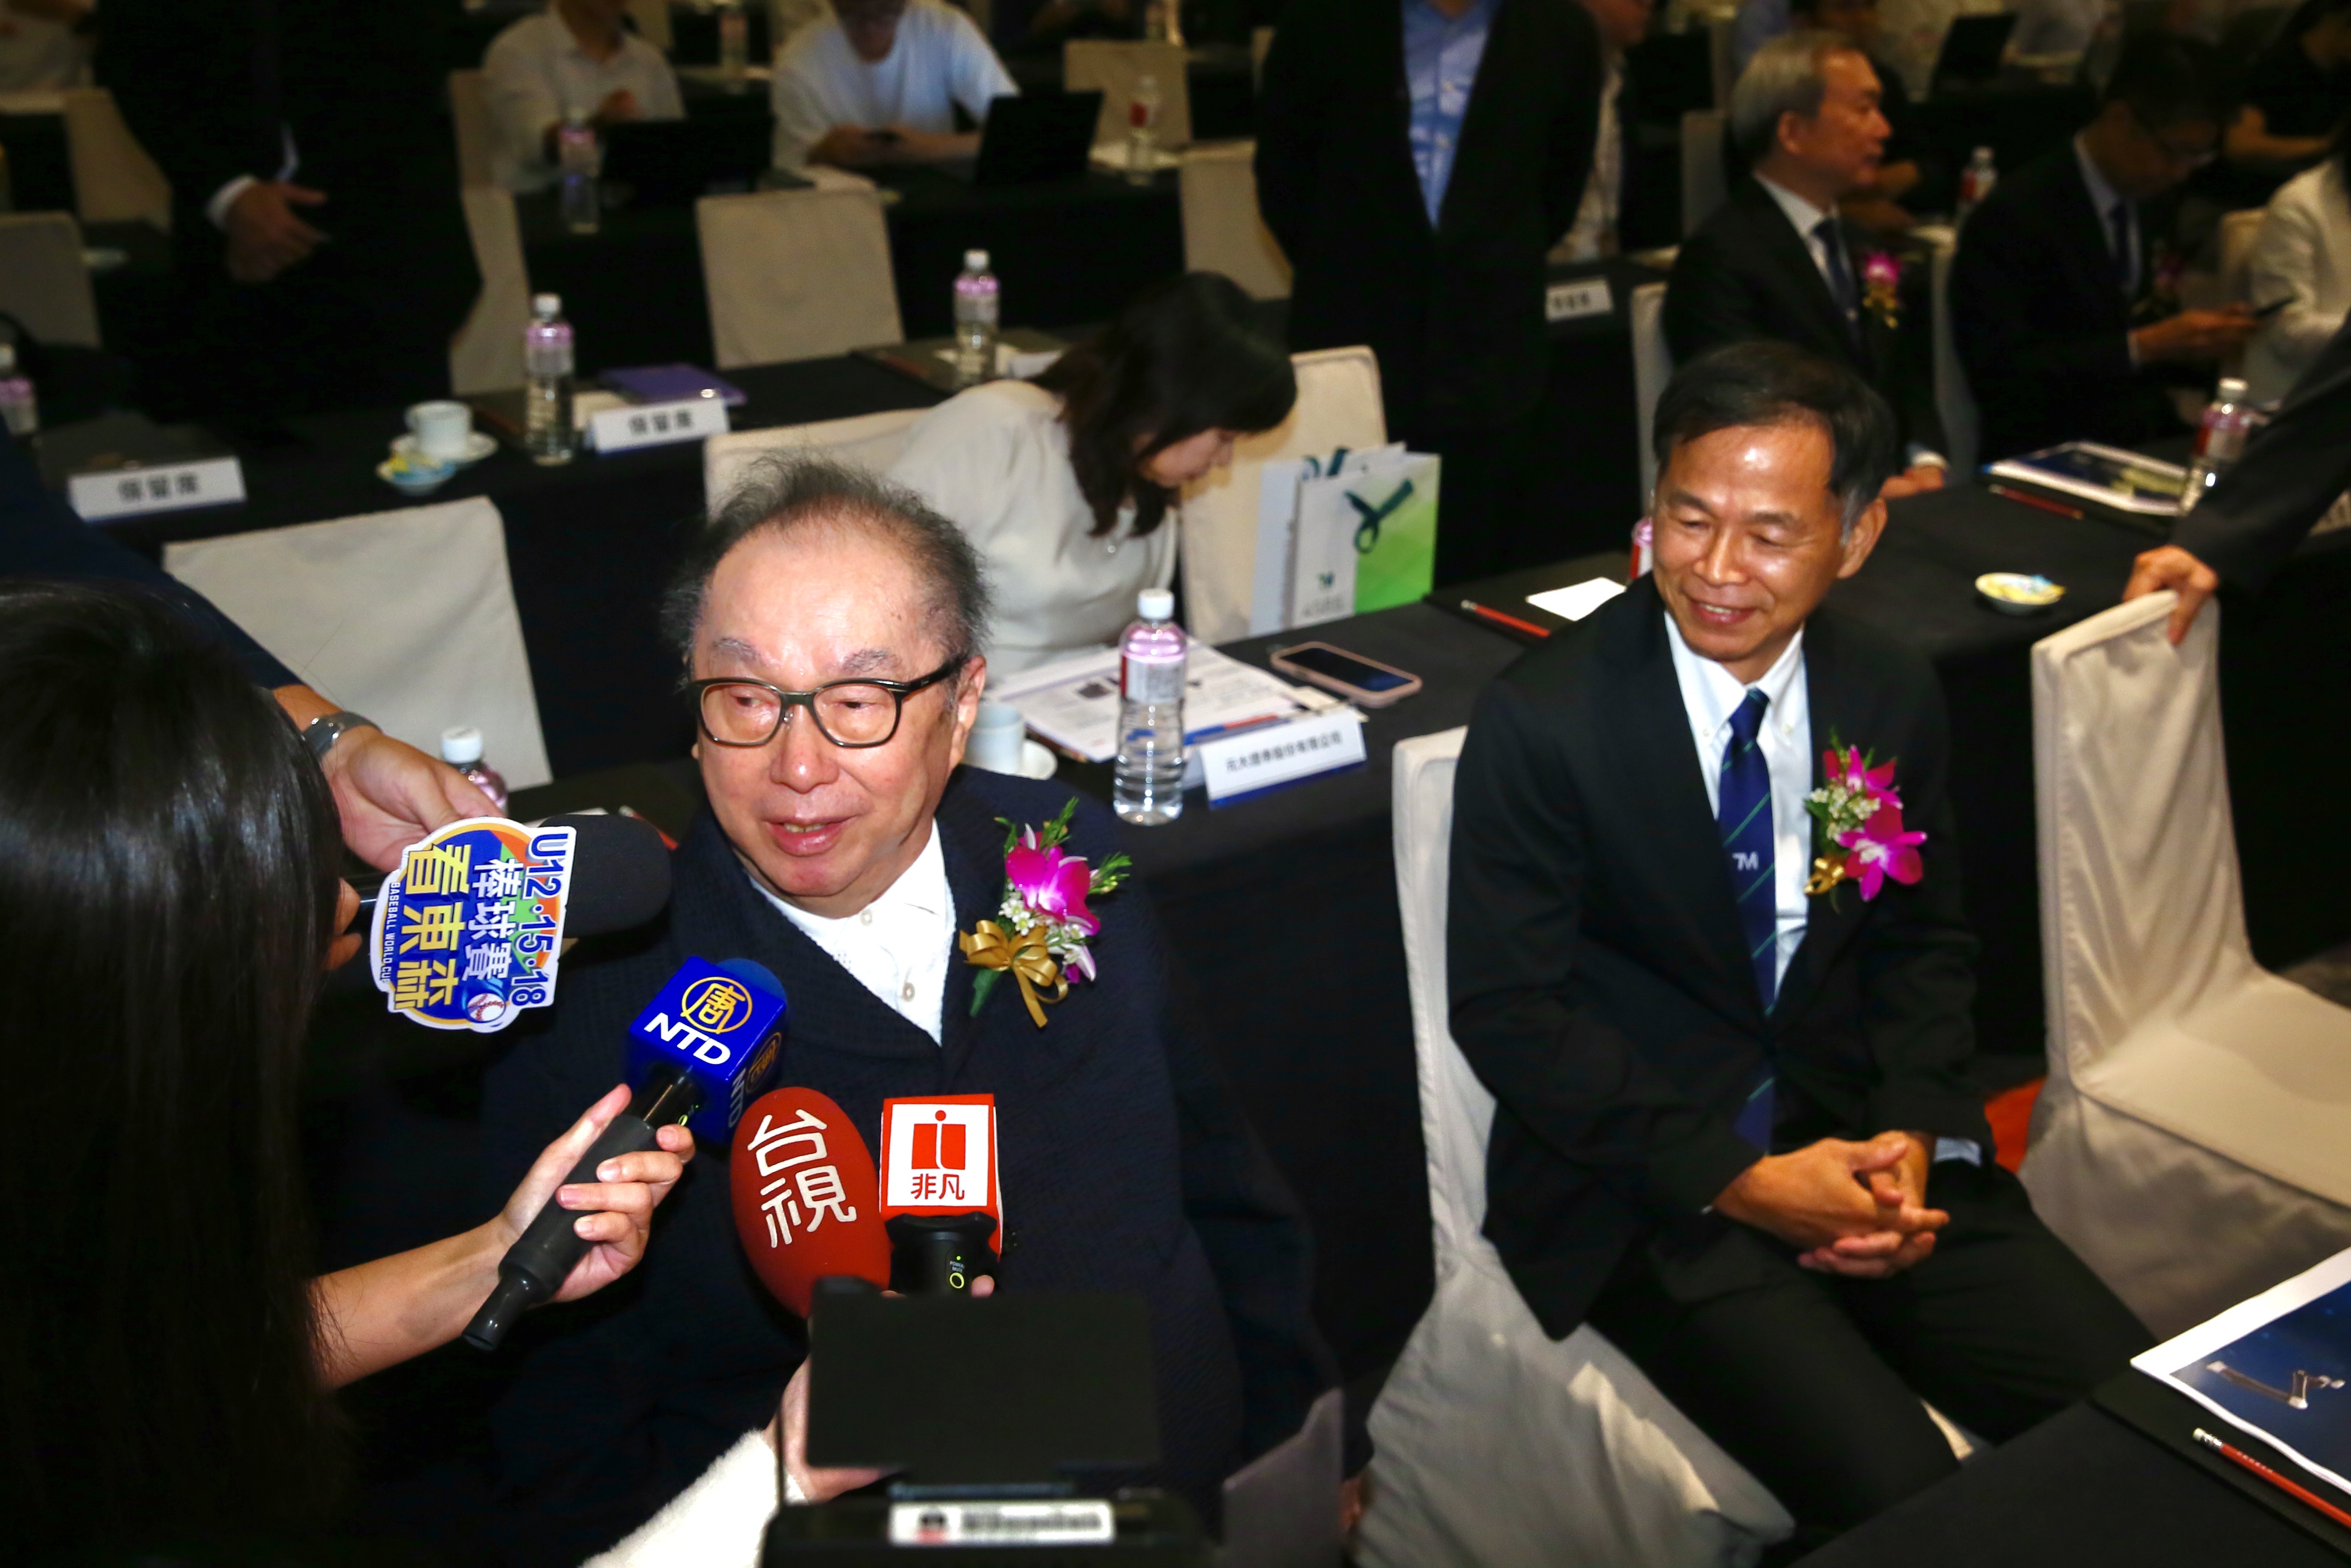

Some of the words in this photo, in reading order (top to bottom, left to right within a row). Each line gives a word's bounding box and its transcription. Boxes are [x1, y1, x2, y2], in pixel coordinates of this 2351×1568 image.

[386, 882, 401, 930] BASEBALL
[394, 843, 471, 1010] 看東森
[462, 858, 524, 981] 棒球賽
[383, 933, 396, 964] WORLD
[644, 1013, 731, 1065] NTD
[747, 1109, 857, 1248] 台視
[911, 1174, 965, 1201] 非凡
